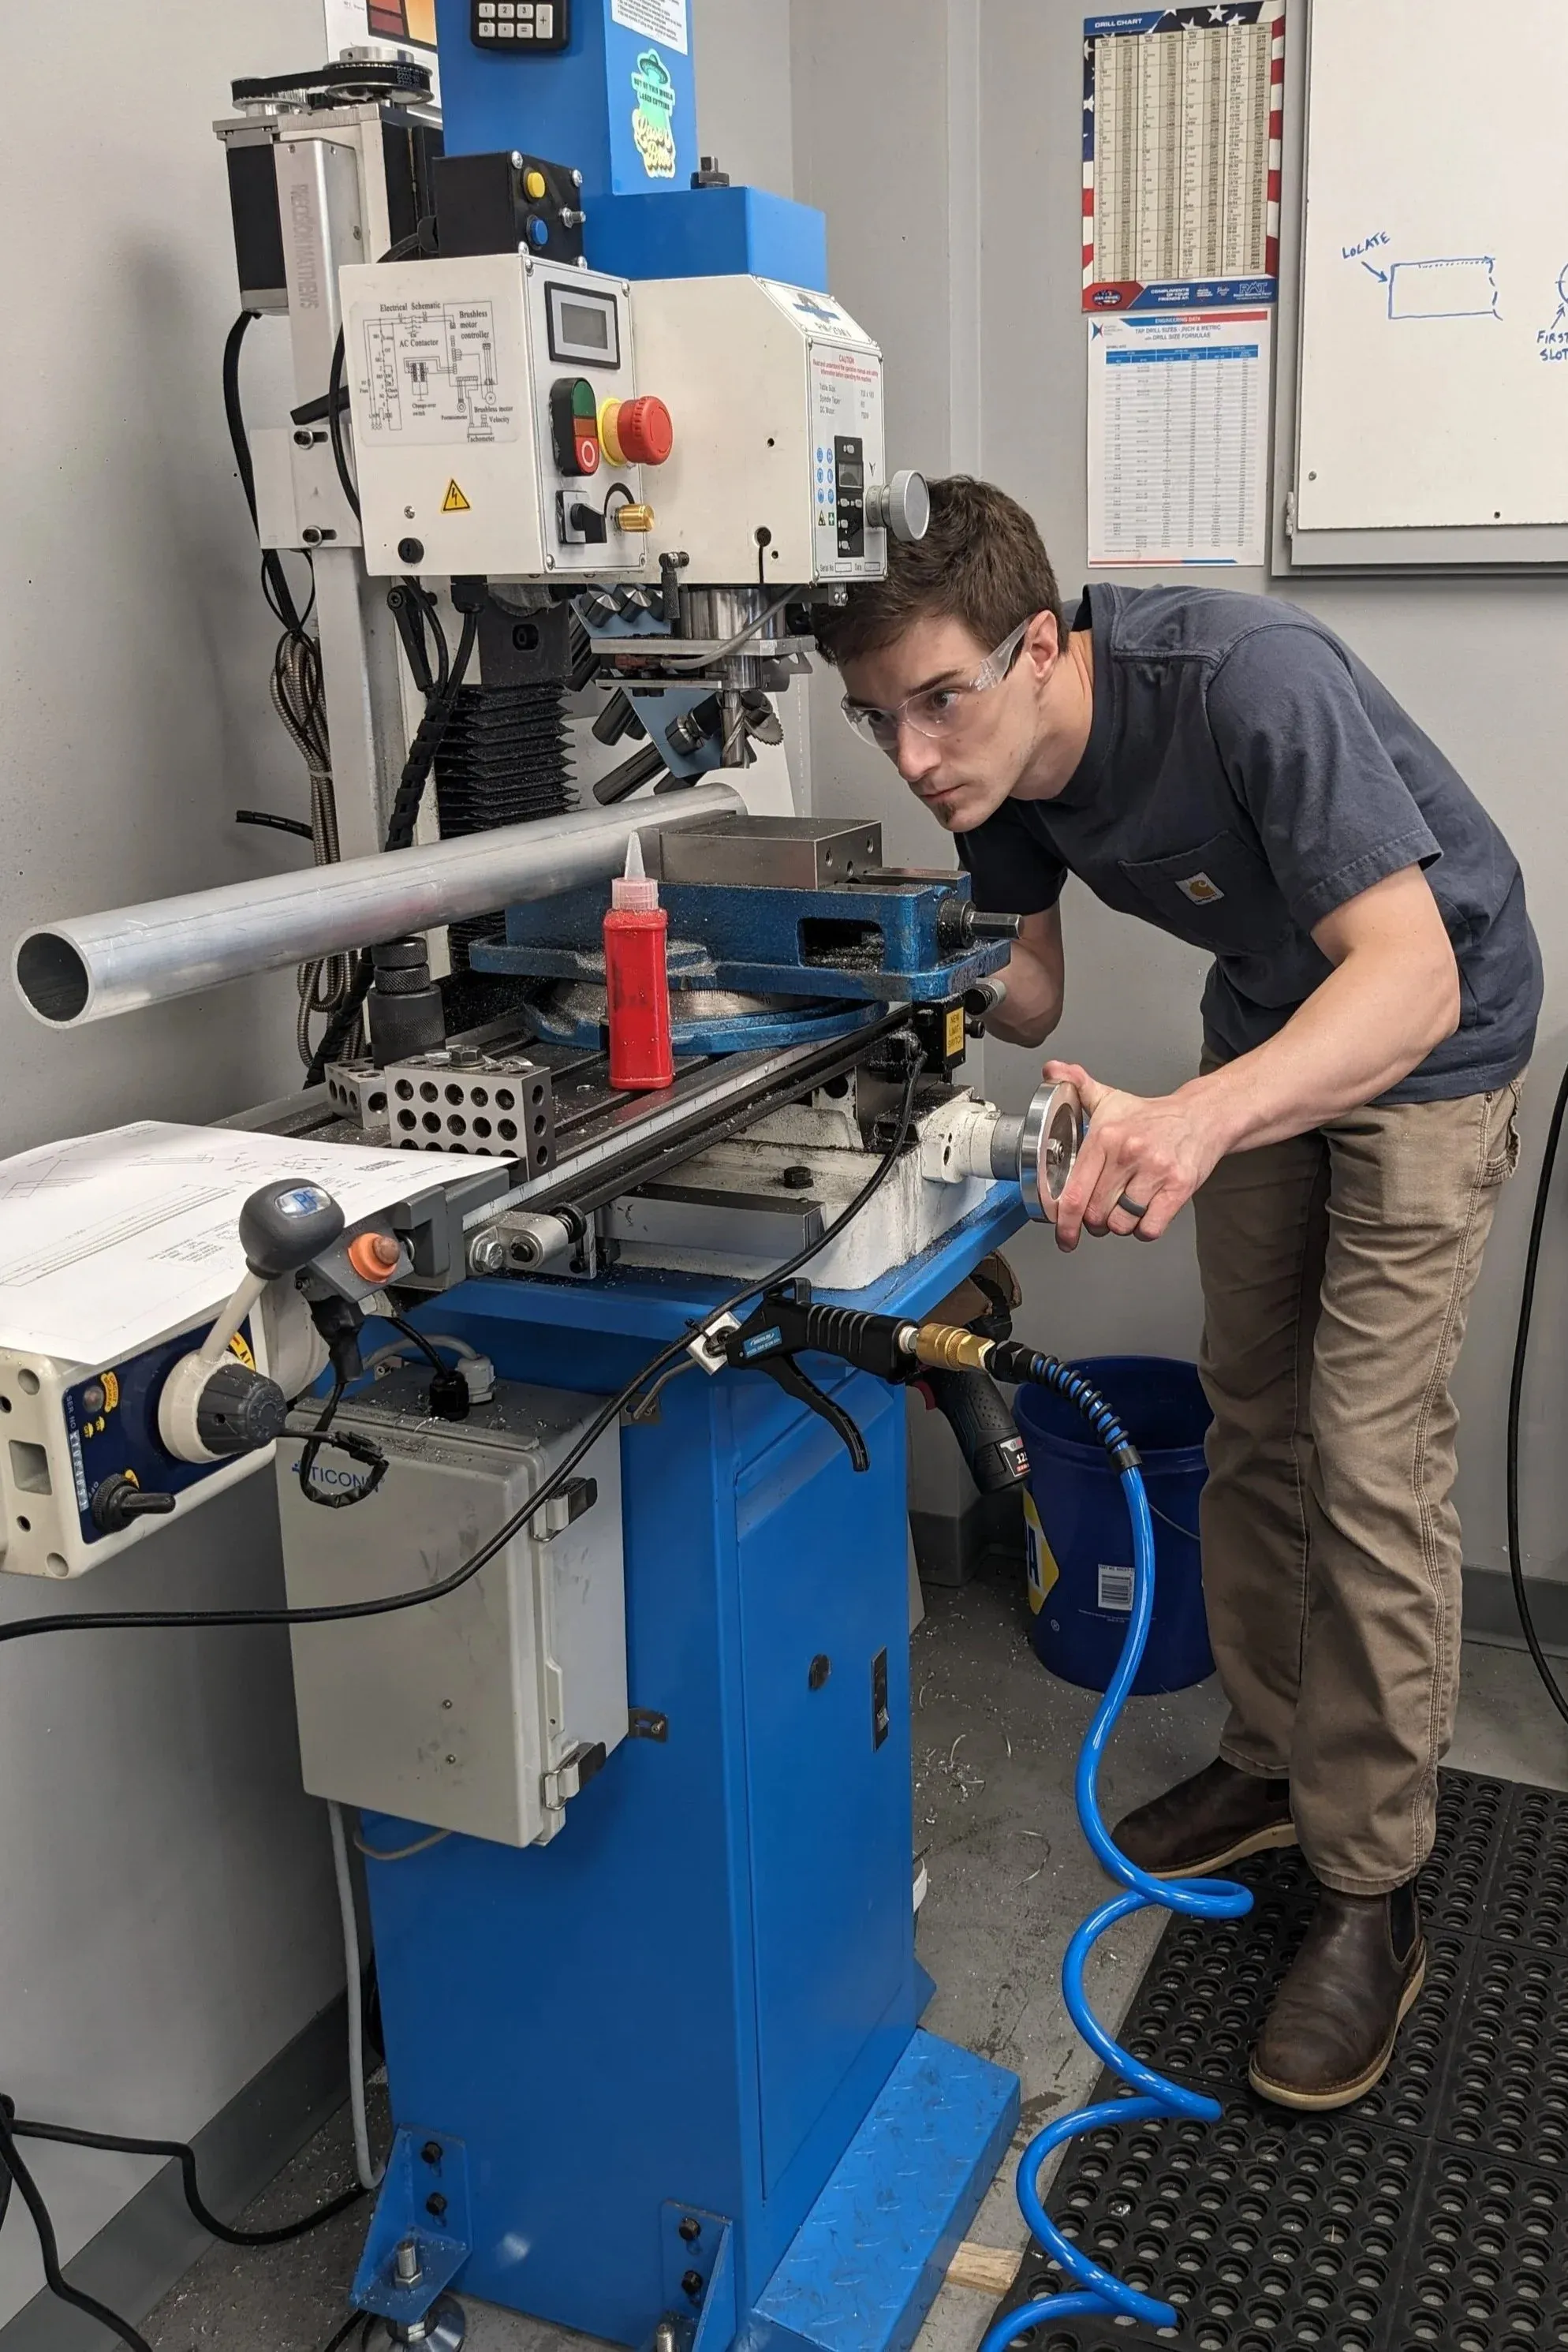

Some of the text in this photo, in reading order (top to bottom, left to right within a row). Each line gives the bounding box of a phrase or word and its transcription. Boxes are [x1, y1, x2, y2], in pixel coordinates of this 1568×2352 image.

[1095, 17, 1143, 28] DRILL CHART
[1342, 231, 1391, 259] LOCATE
[380, 301, 441, 312] Electrical Schematic
[459, 310, 487, 319] Brushless
[461, 330, 489, 339] controller
[1536, 330, 1568, 344] FIRST
[410, 338, 439, 347] Contactor
[838, 354, 854, 364] CAUTION
[1540, 348, 1568, 361] SLOT
[489, 416, 510, 424] Velocity
[950, 1013, 960, 1023] NEW
[65, 1394, 74, 1414] SER
[69, 1416, 77, 1429] NO
[311, 1466, 379, 1493] TICON
